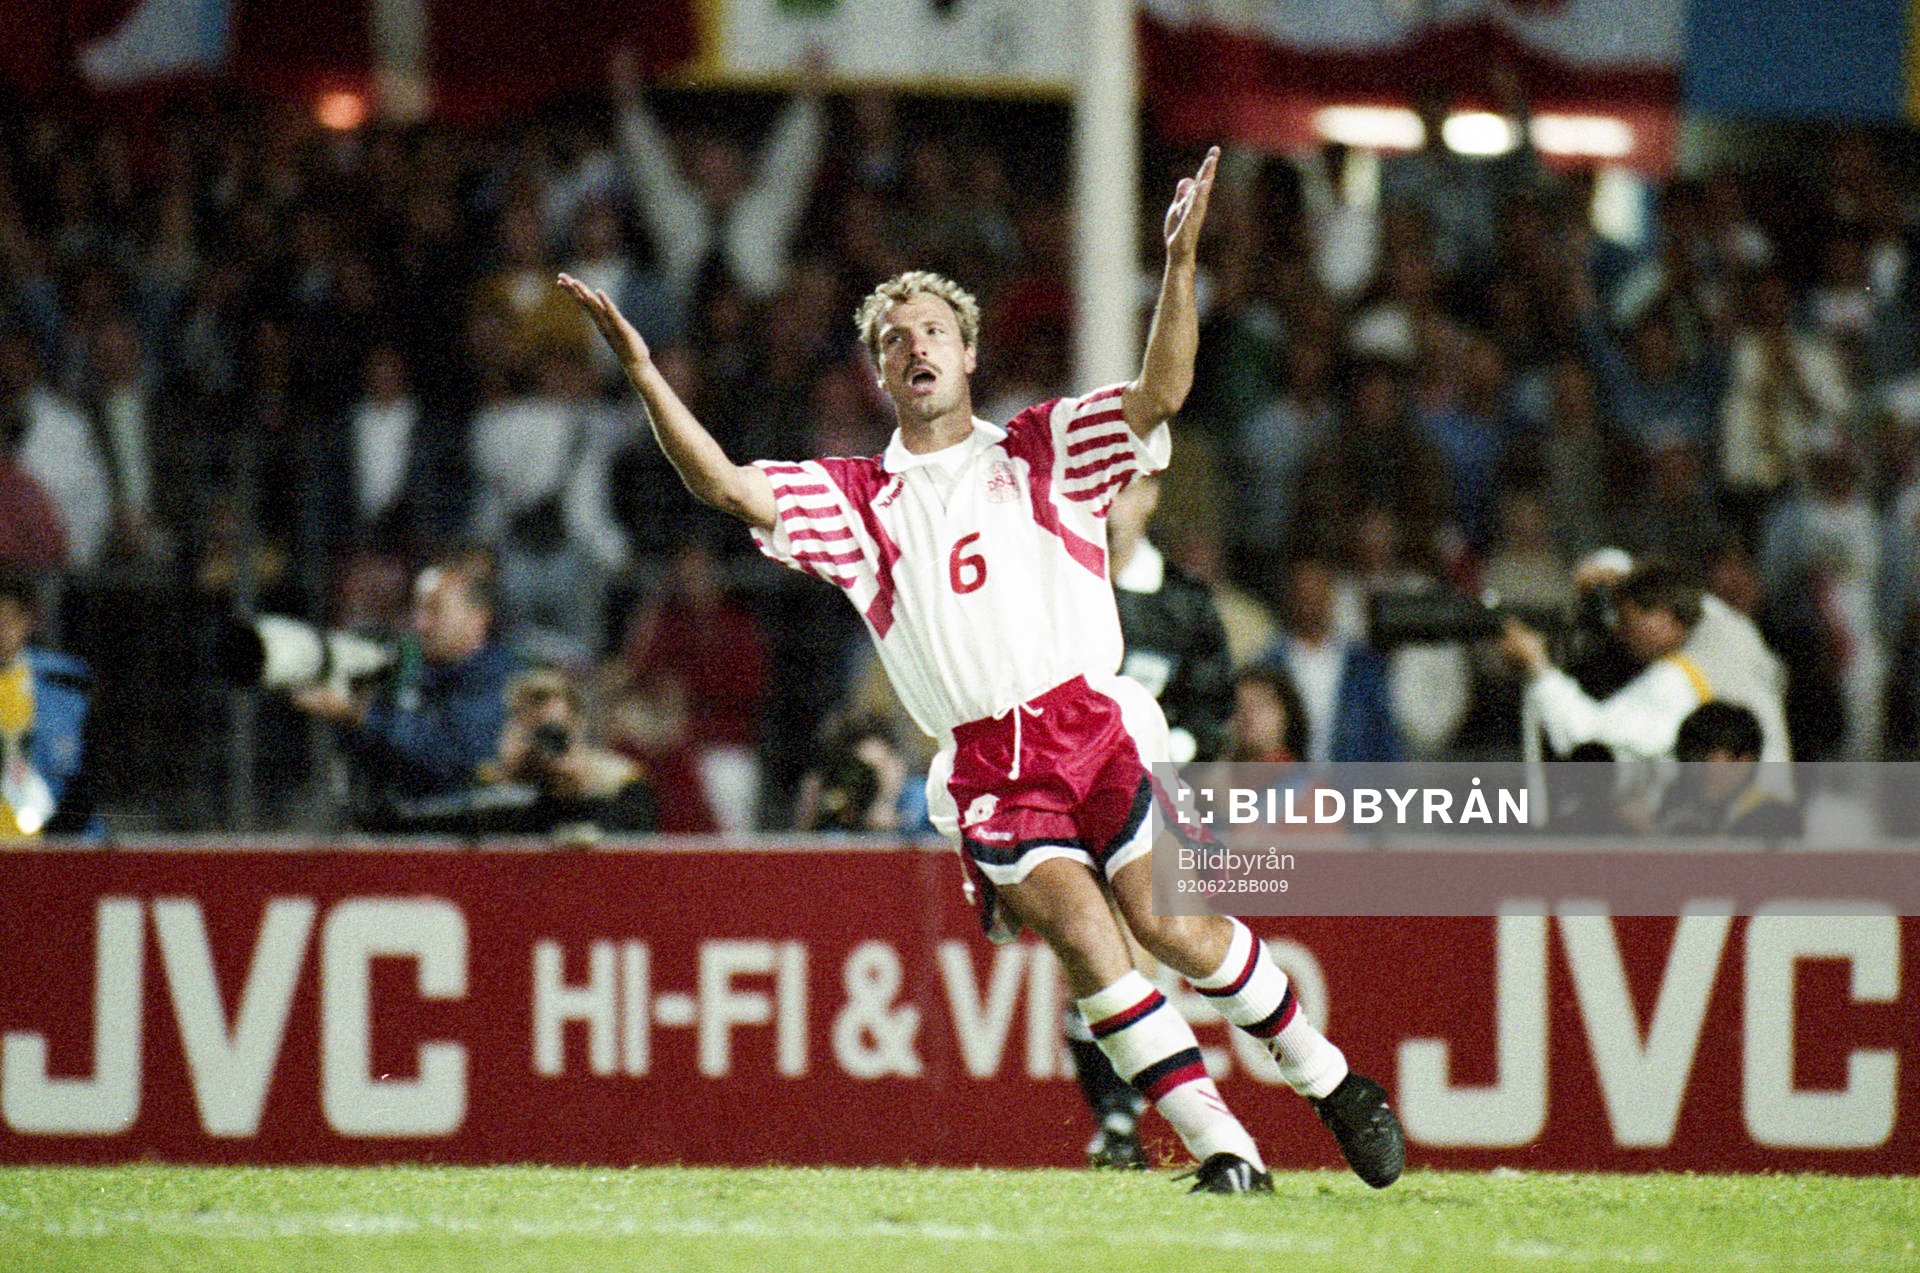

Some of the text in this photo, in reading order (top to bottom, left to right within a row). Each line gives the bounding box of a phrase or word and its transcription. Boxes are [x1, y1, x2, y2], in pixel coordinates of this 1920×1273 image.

[949, 531, 987, 595] 6
[2, 896, 468, 1138] JVC
[533, 938, 1330, 1083] HI-FI & VIO
[1398, 899, 1902, 1149] JVC
